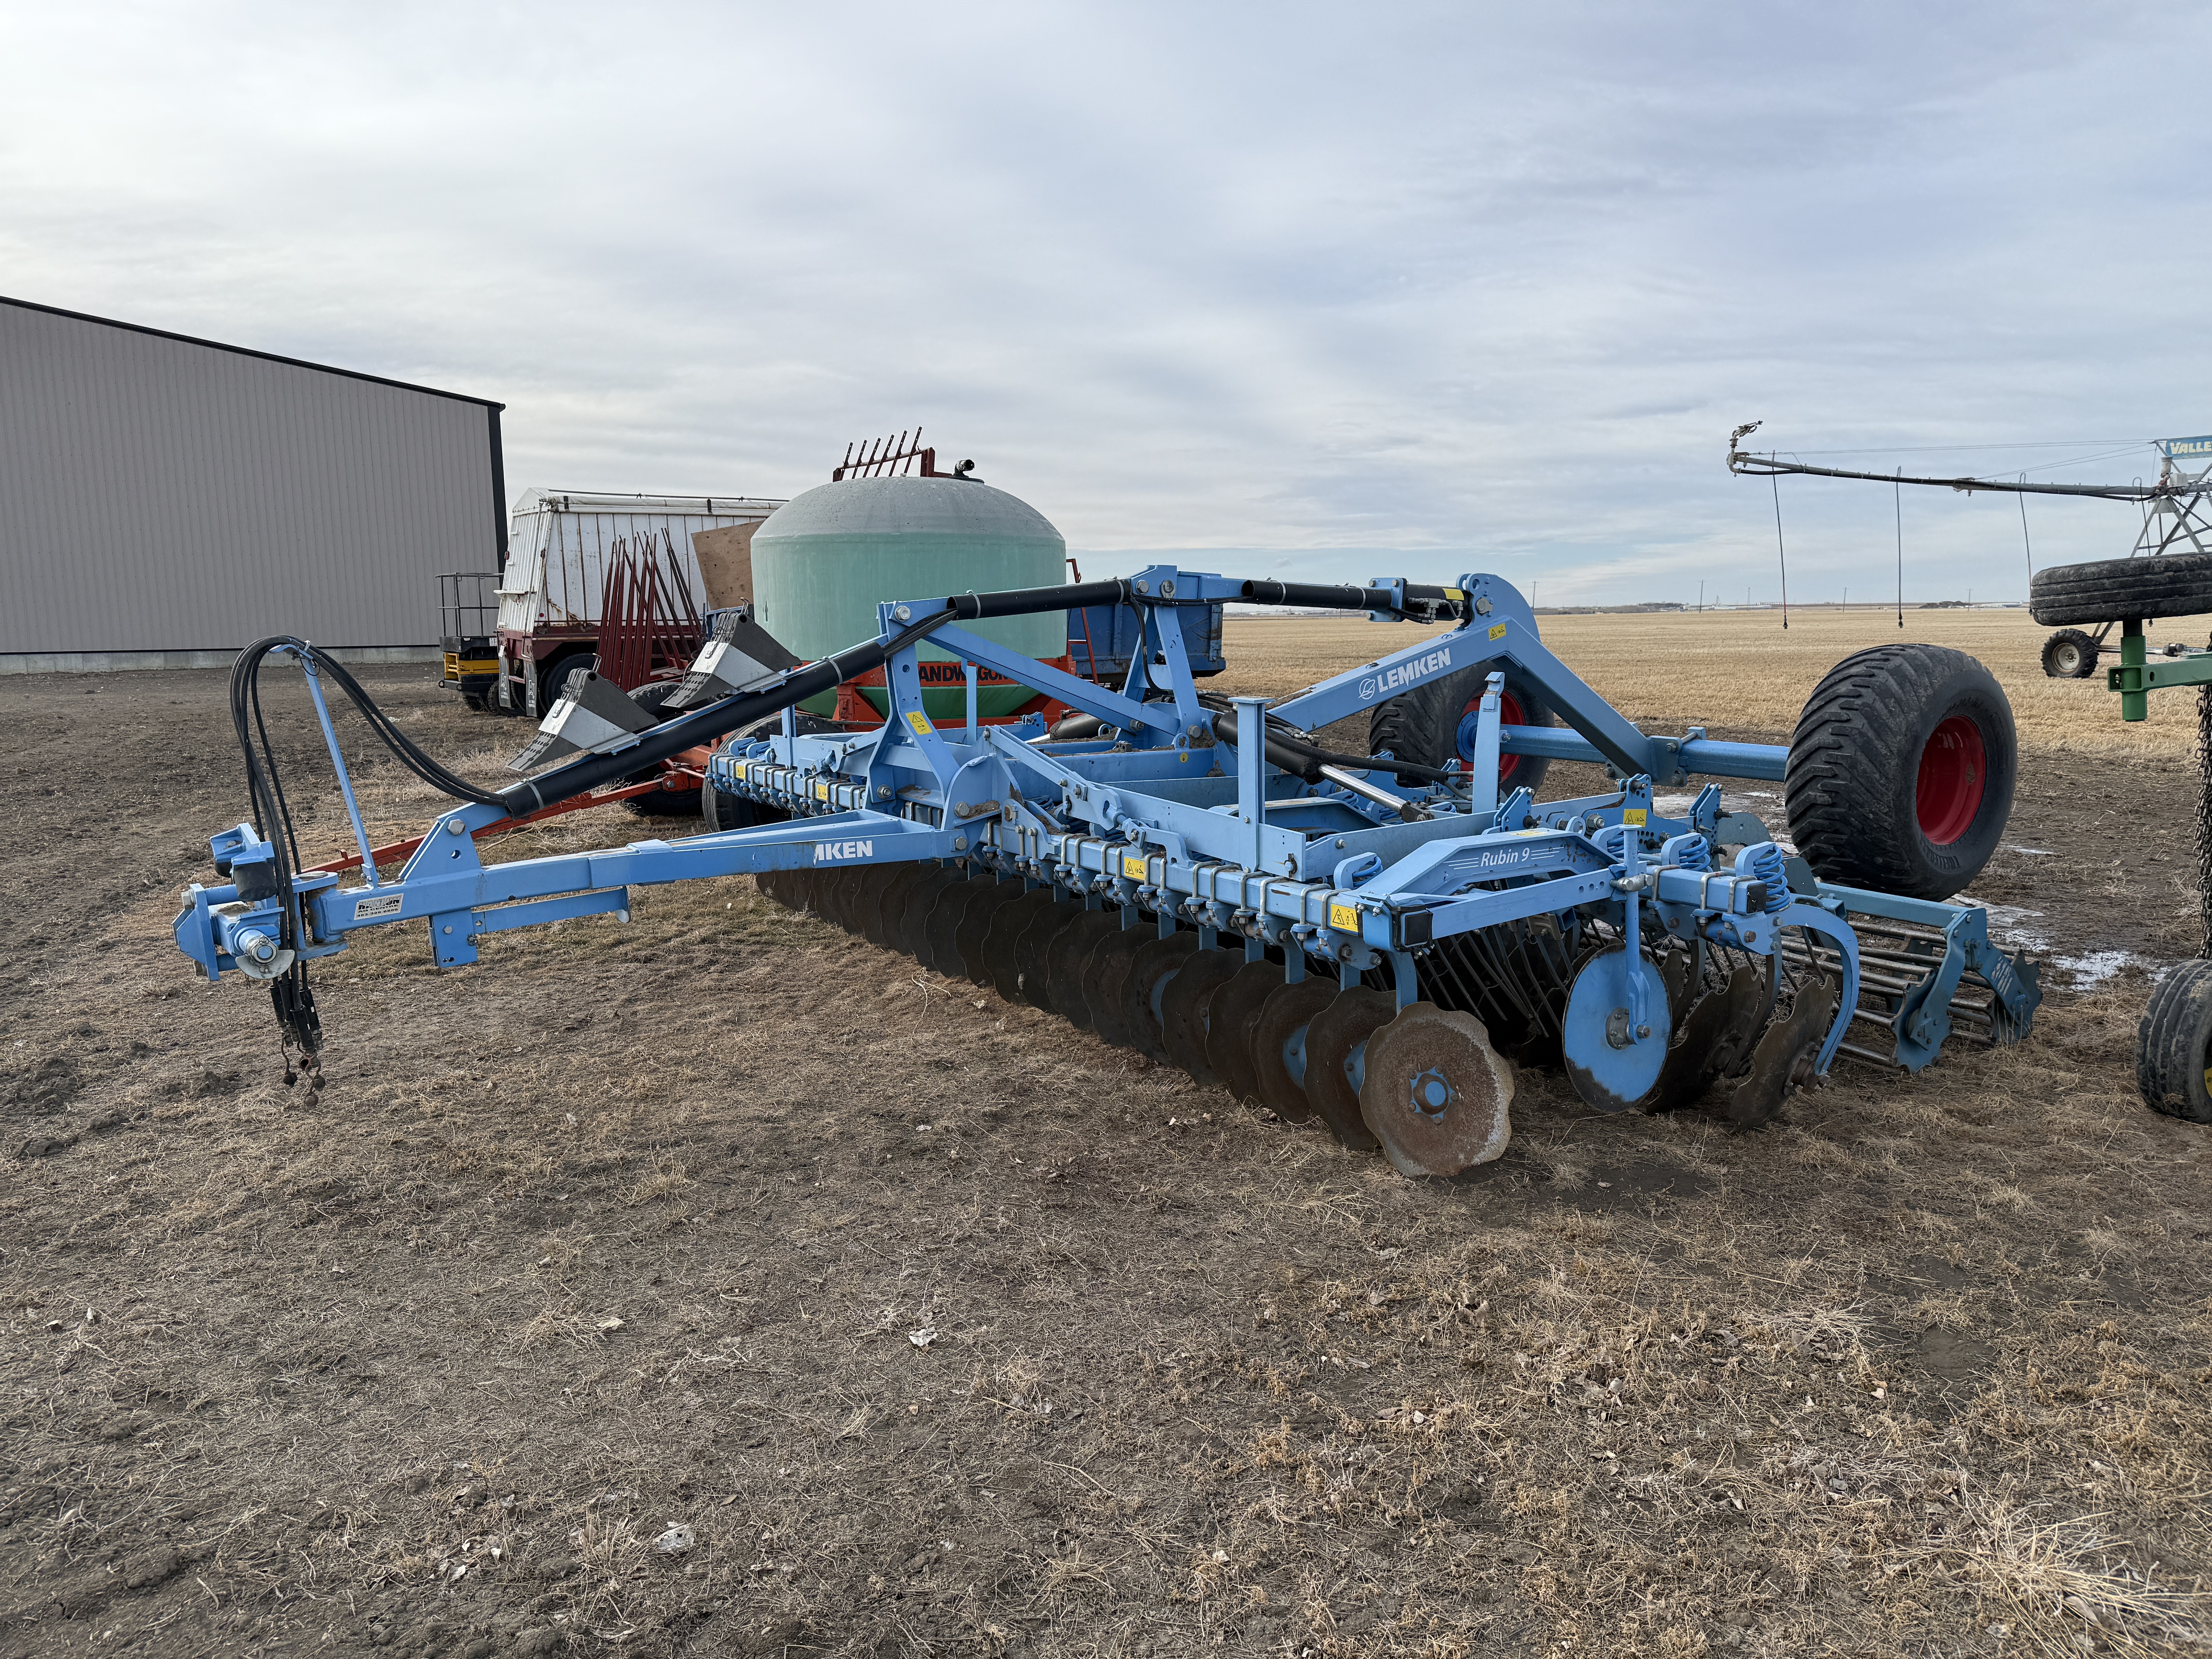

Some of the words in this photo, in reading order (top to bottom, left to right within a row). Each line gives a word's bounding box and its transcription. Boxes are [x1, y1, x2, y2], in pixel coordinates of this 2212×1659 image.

[2170, 441, 2212, 454] VALLE
[1377, 647, 1451, 693] LEMKEN
[1480, 849, 1518, 867] Rubin
[1522, 847, 1530, 862] 9
[359, 895, 401, 910] HANLON
